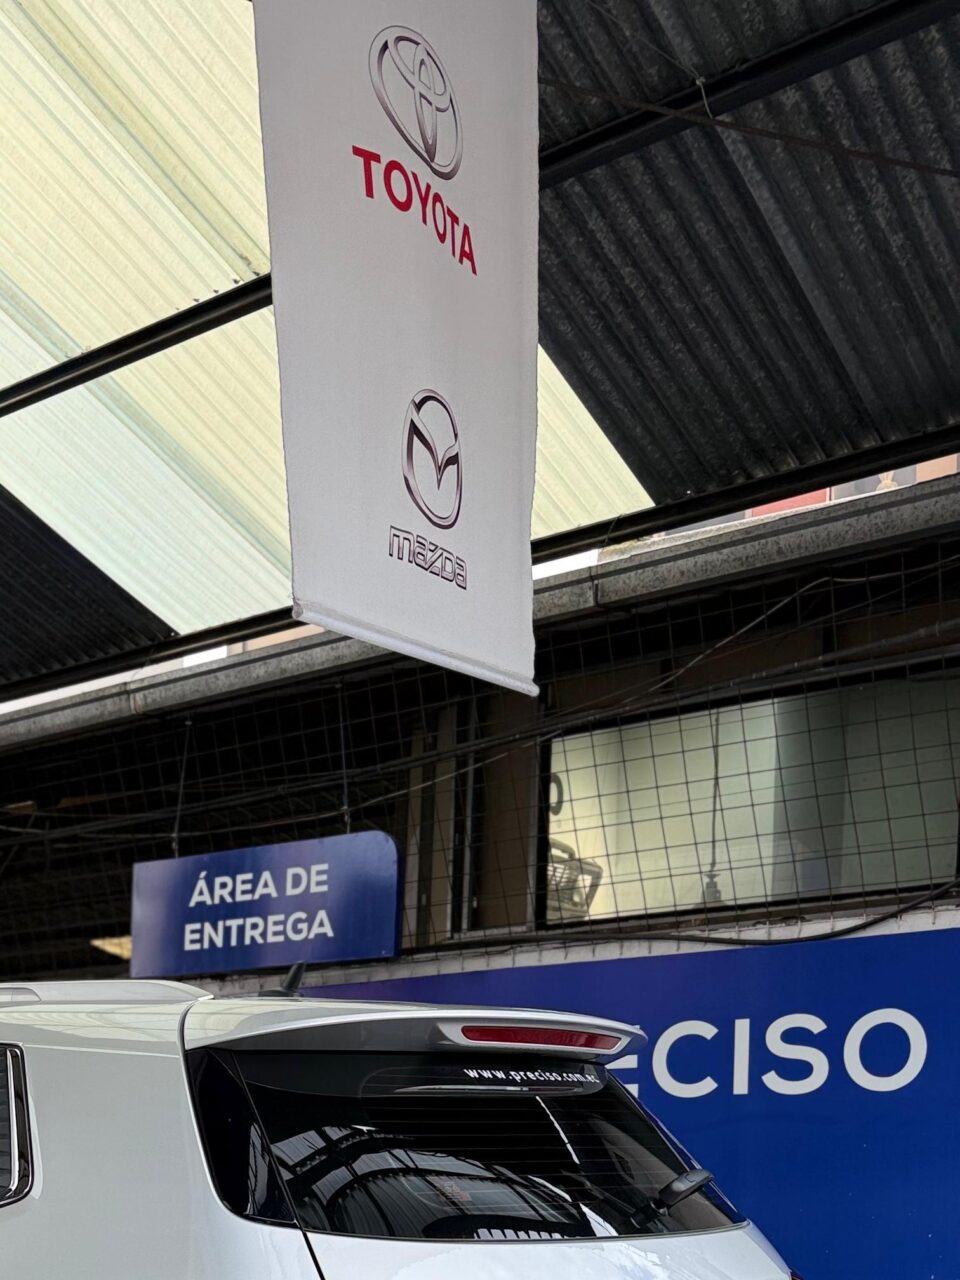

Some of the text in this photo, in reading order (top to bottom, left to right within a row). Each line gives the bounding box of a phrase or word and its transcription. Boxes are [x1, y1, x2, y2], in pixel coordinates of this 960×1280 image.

[351, 145, 478, 276] TOYOTA
[188, 863, 330, 908] ÁREA DE
[183, 909, 335, 951] ENTREGA
[464, 1068, 600, 1084] www.preciso.com.ec
